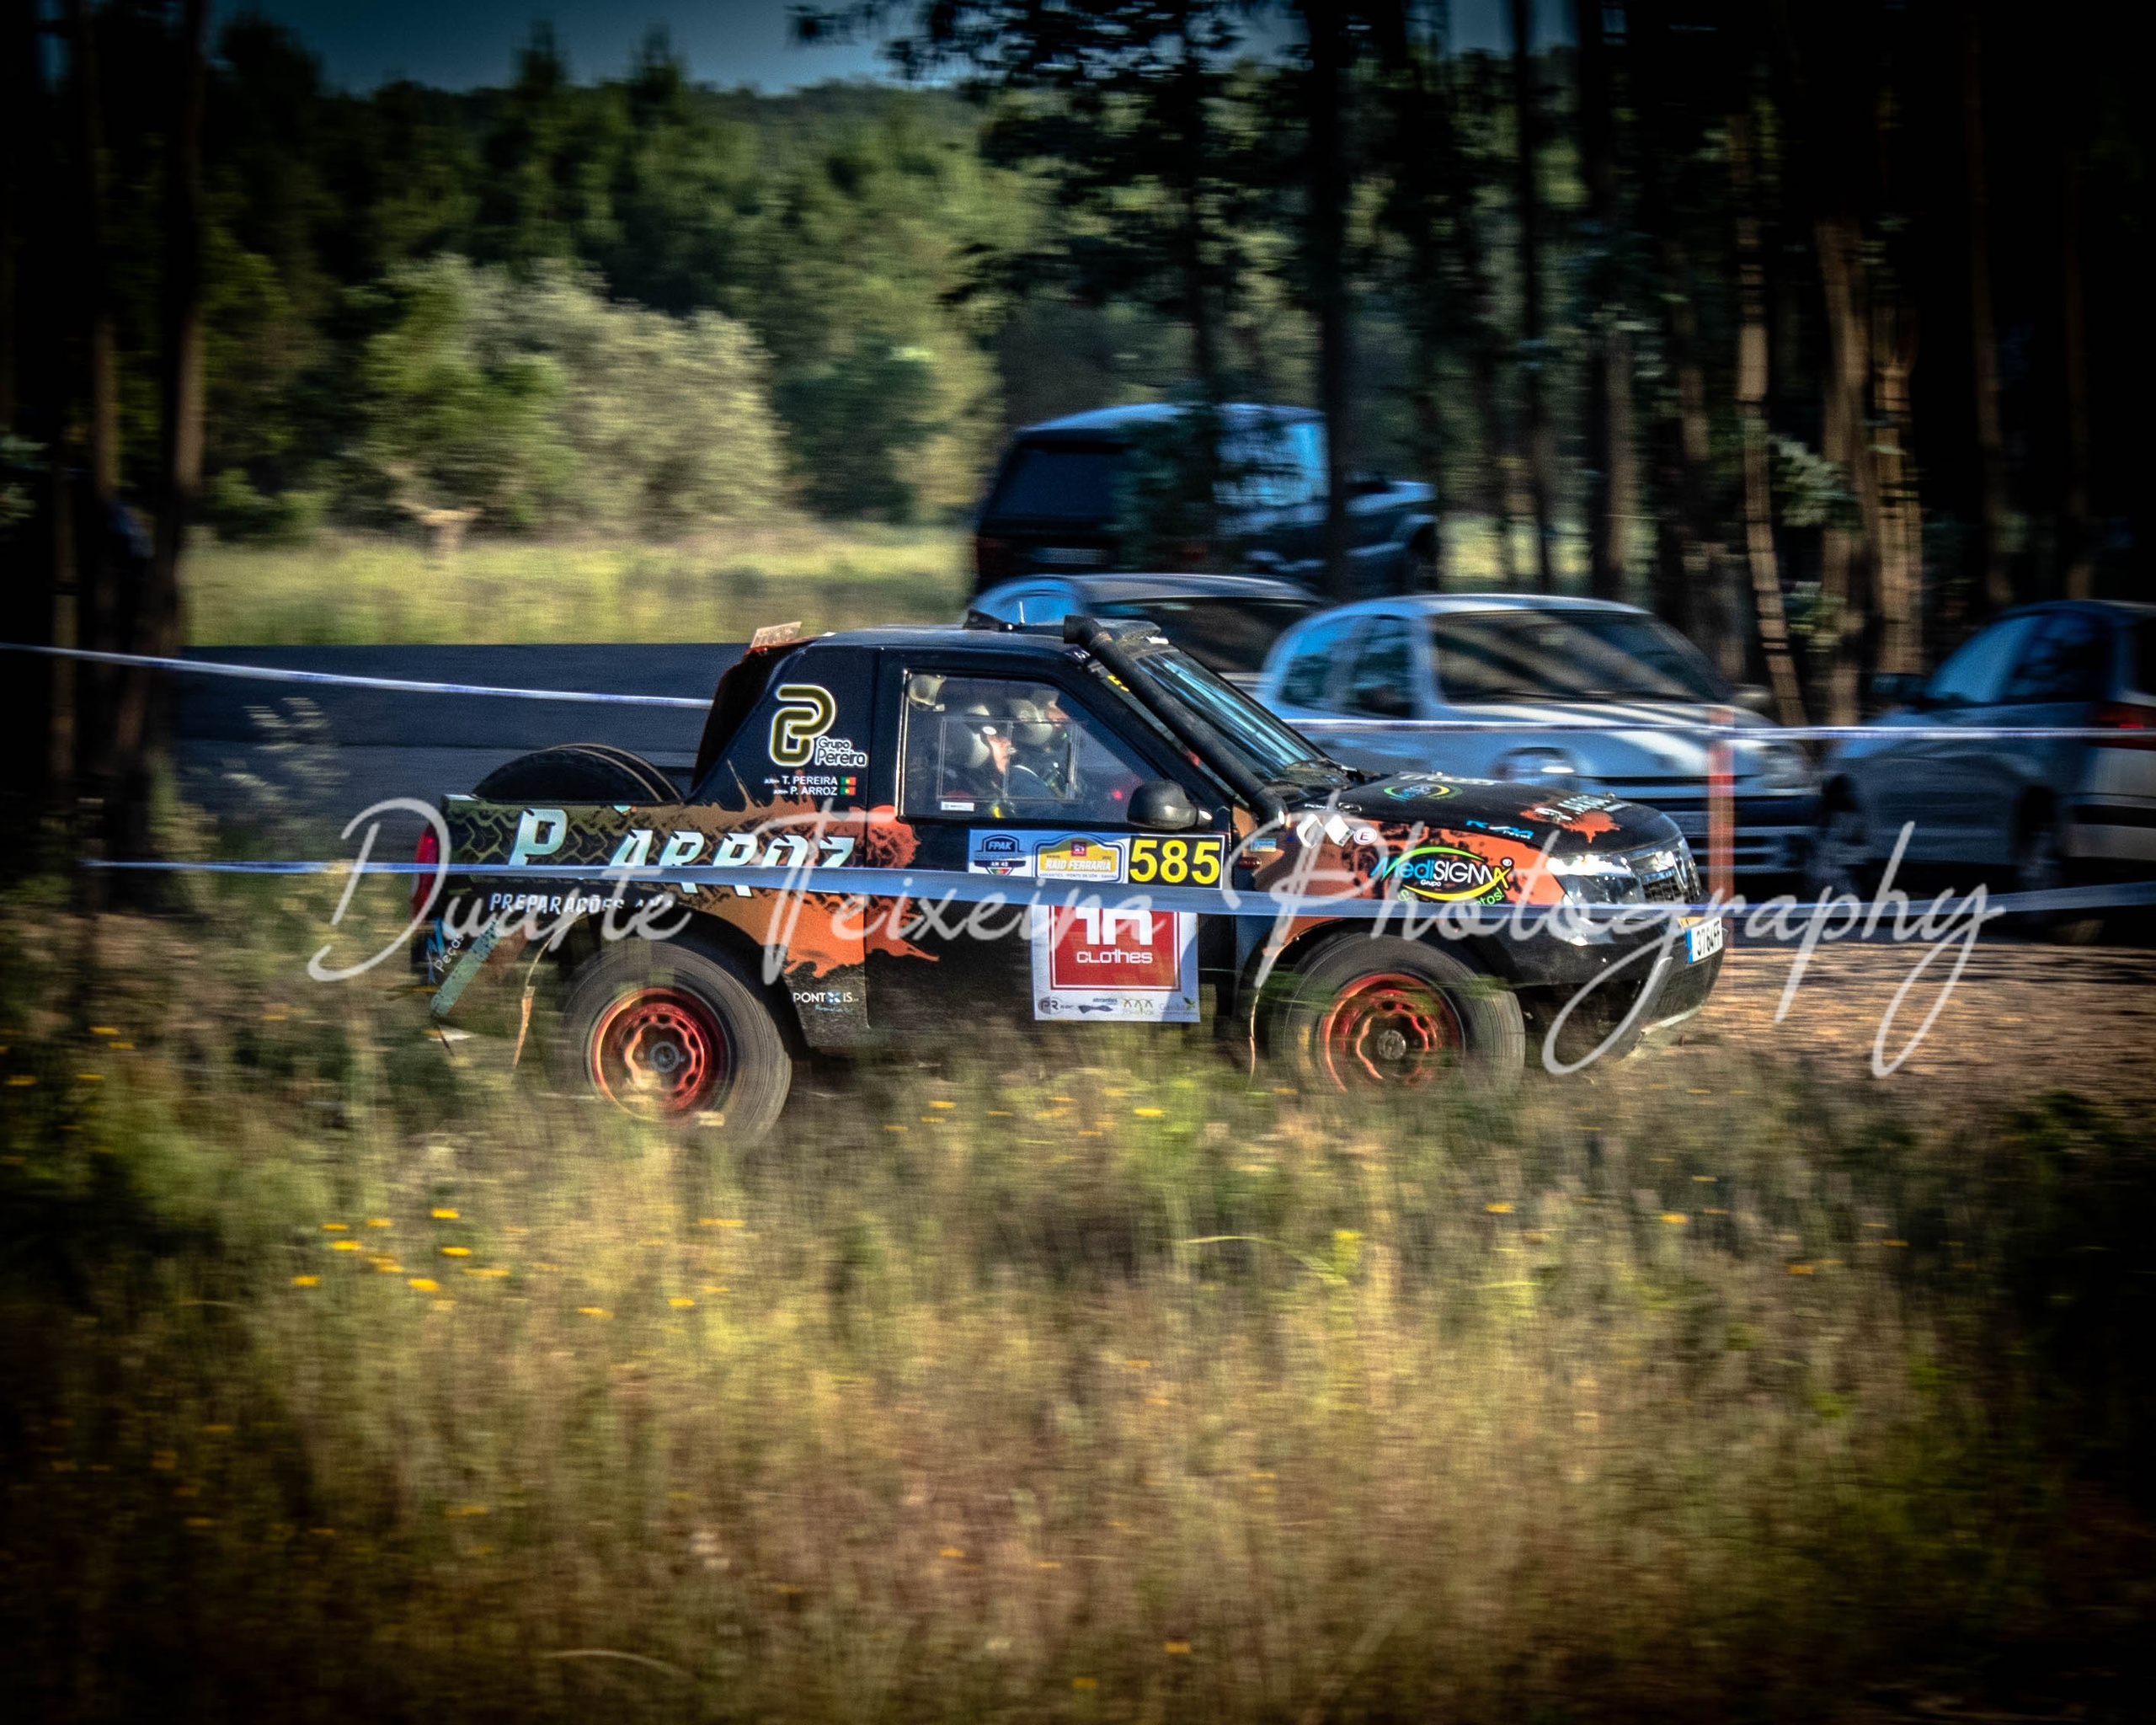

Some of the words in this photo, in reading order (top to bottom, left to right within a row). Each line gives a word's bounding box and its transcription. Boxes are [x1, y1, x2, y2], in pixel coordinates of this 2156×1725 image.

[817, 737, 851, 753] Grupo
[815, 748, 867, 766] Pereira
[782, 775, 791, 785] T.
[792, 776, 838, 785] PEREIRA
[789, 786, 798, 796] P.
[801, 787, 838, 796] ARROZ
[1045, 858, 1066, 871] RAID
[1067, 859, 1112, 873] FERRARIA
[1129, 839, 1221, 885] 585
[1420, 879, 1442, 888] Grupo
